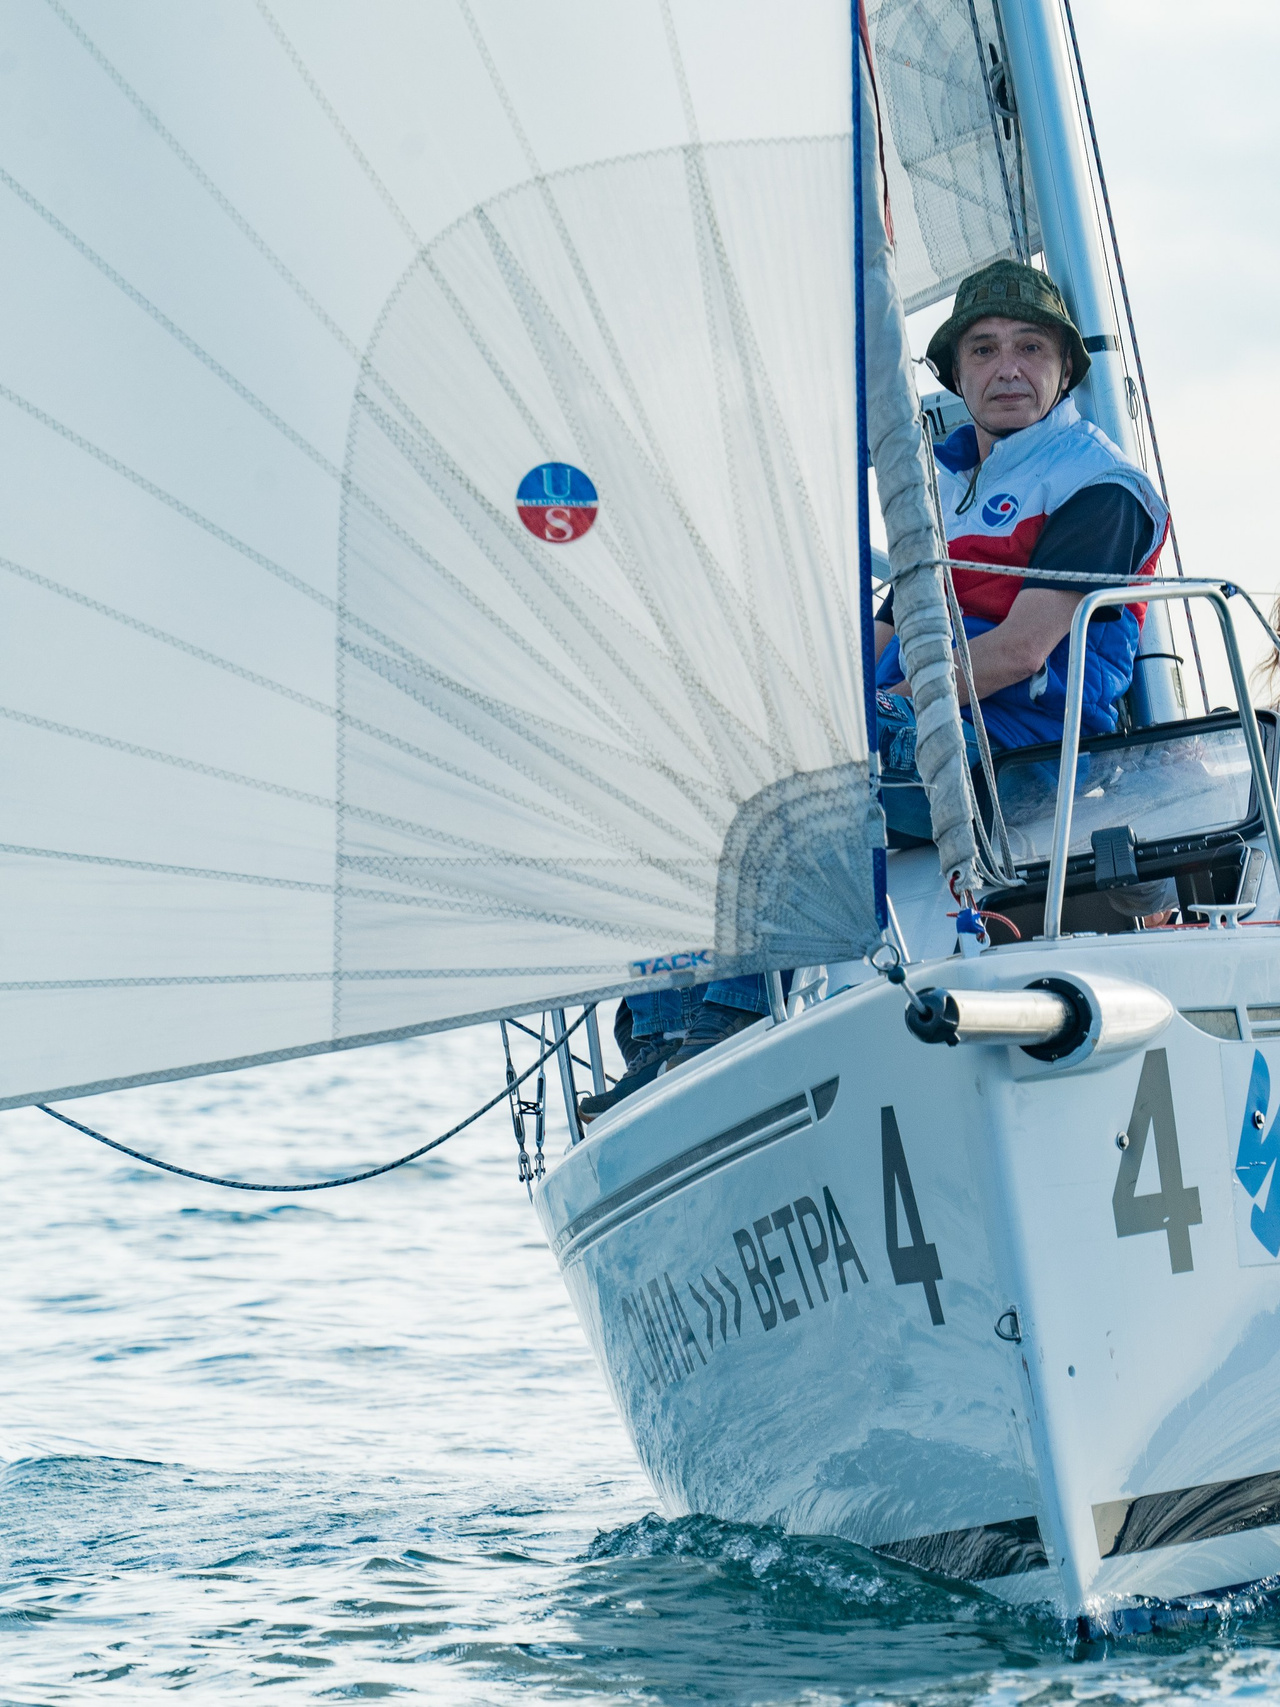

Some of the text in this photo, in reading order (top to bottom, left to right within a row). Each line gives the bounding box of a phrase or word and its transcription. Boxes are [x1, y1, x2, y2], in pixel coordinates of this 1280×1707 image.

[542, 468, 571, 498] U
[545, 507, 573, 541] S
[632, 949, 711, 977] TACK
[880, 1104, 946, 1327] 4
[1111, 1047, 1203, 1275] 4
[620, 1185, 869, 1396] СИЛА ВЕТРА
